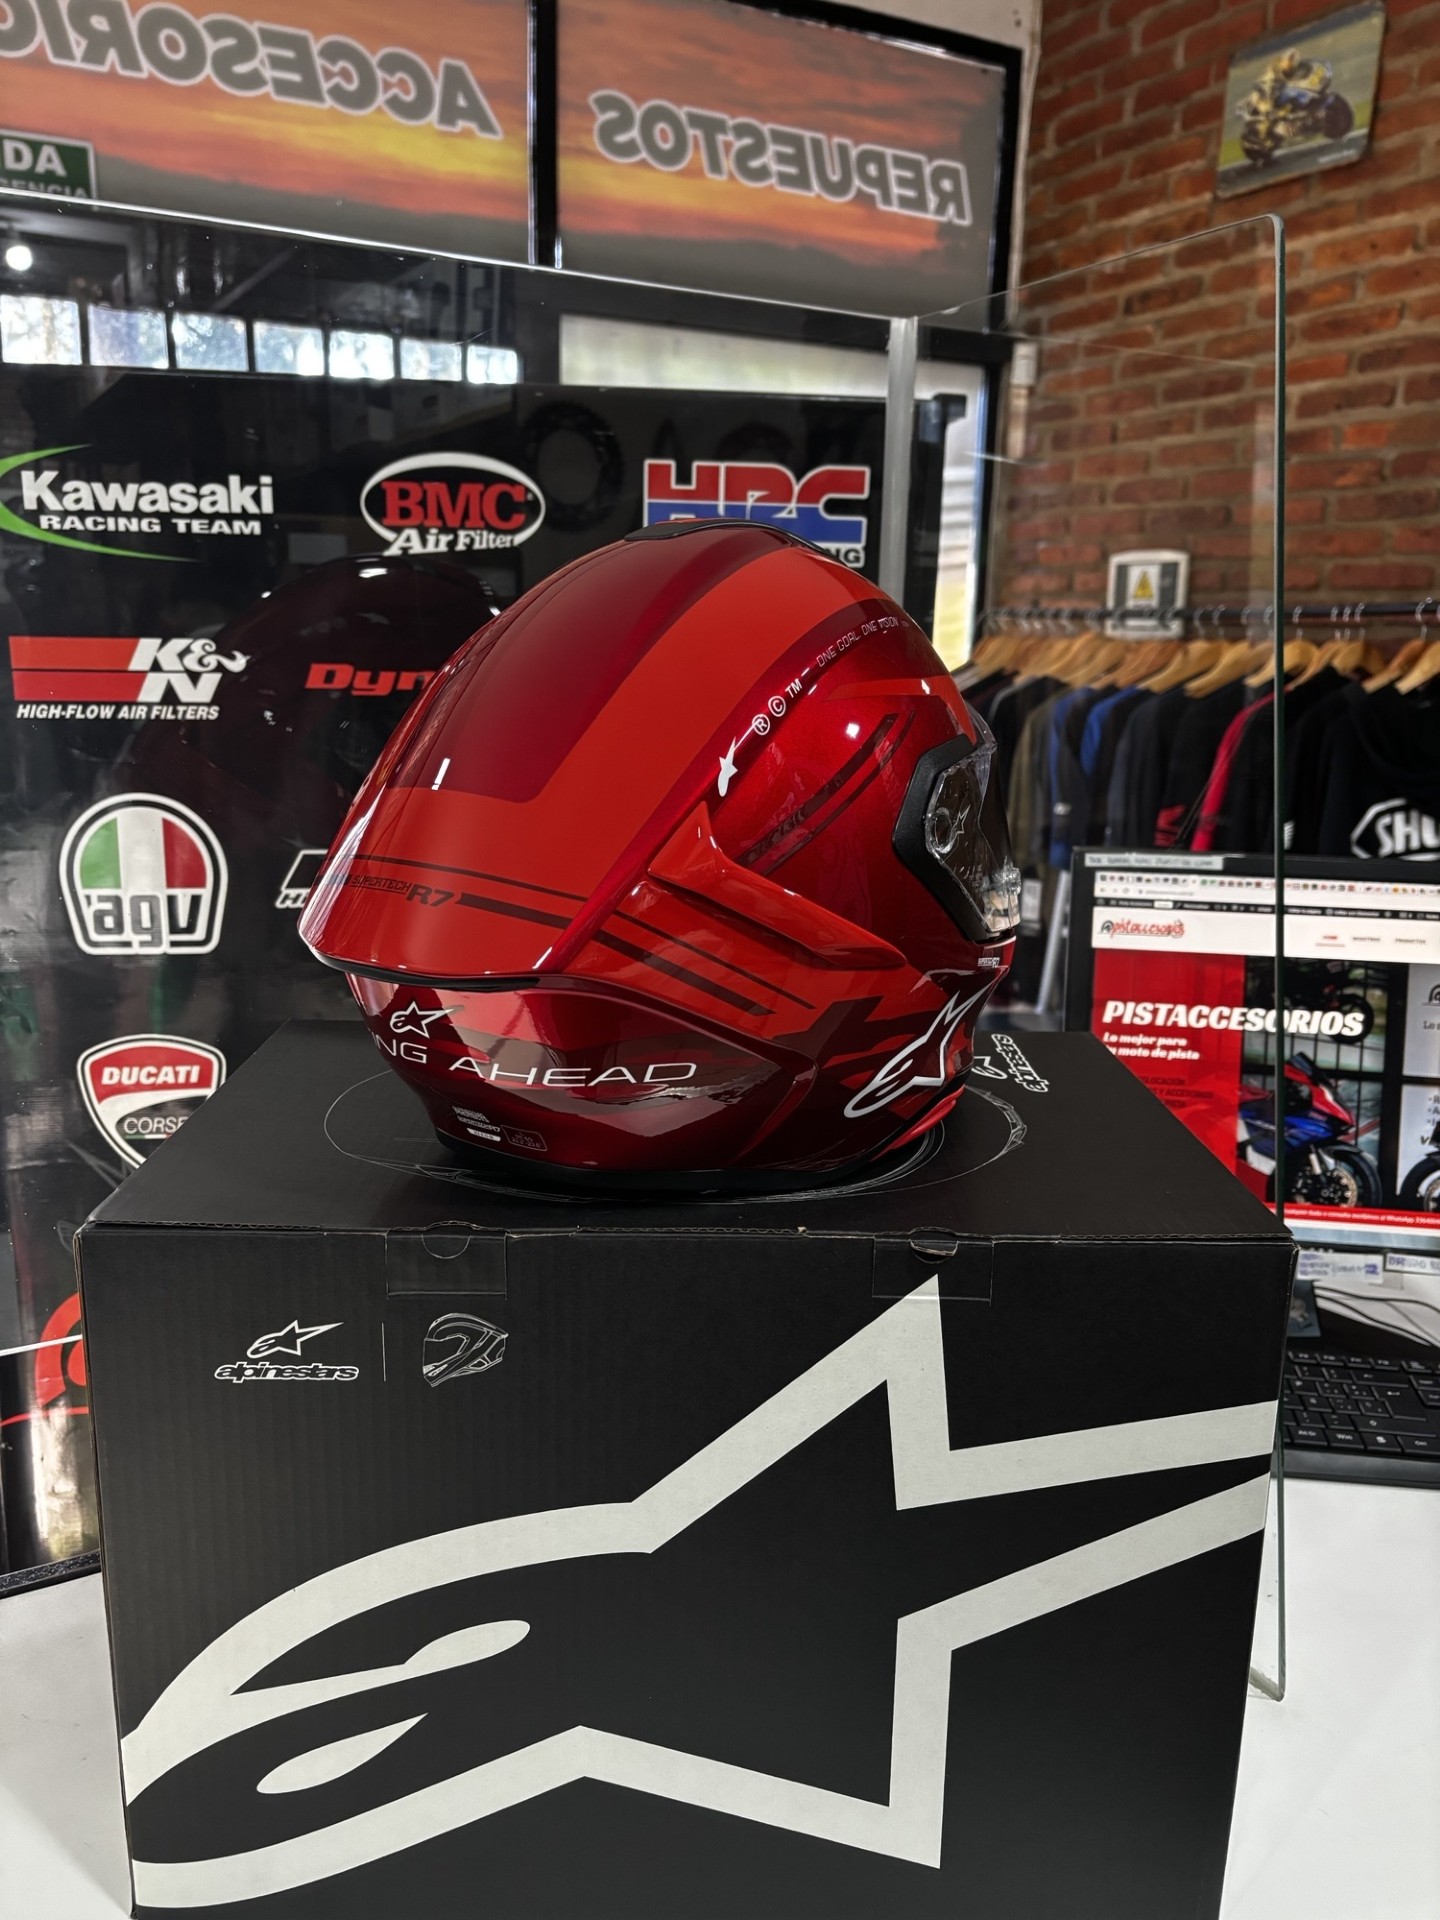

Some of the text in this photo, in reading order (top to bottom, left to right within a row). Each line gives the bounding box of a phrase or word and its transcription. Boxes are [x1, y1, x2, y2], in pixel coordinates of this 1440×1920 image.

[21, 469, 274, 514] Kawasaki
[643, 459, 870, 545] HRC
[381, 481, 526, 529] BMC
[39, 515, 262, 535] RACING TEAM
[384, 528, 516, 556] Air Filter
[816, 645, 837, 668] ONE
[16, 704, 219, 720] HIGH-FLOW AIR FILTERS
[351, 874, 455, 907] SUPERTECH R7
[85, 890, 204, 949] agv
[1102, 1000, 1365, 1037] PISTACCESORIOS
[1103, 1032, 1187, 1048] Lo mejor para
[1117, 1047, 1150, 1057] moto
[1151, 1047, 1167, 1058] de
[1168, 1049, 1200, 1061] pista
[101, 1065, 201, 1085] DUCATI
[448, 1061, 699, 1087] AHEAD
[214, 1361, 359, 1384] alpinestars
